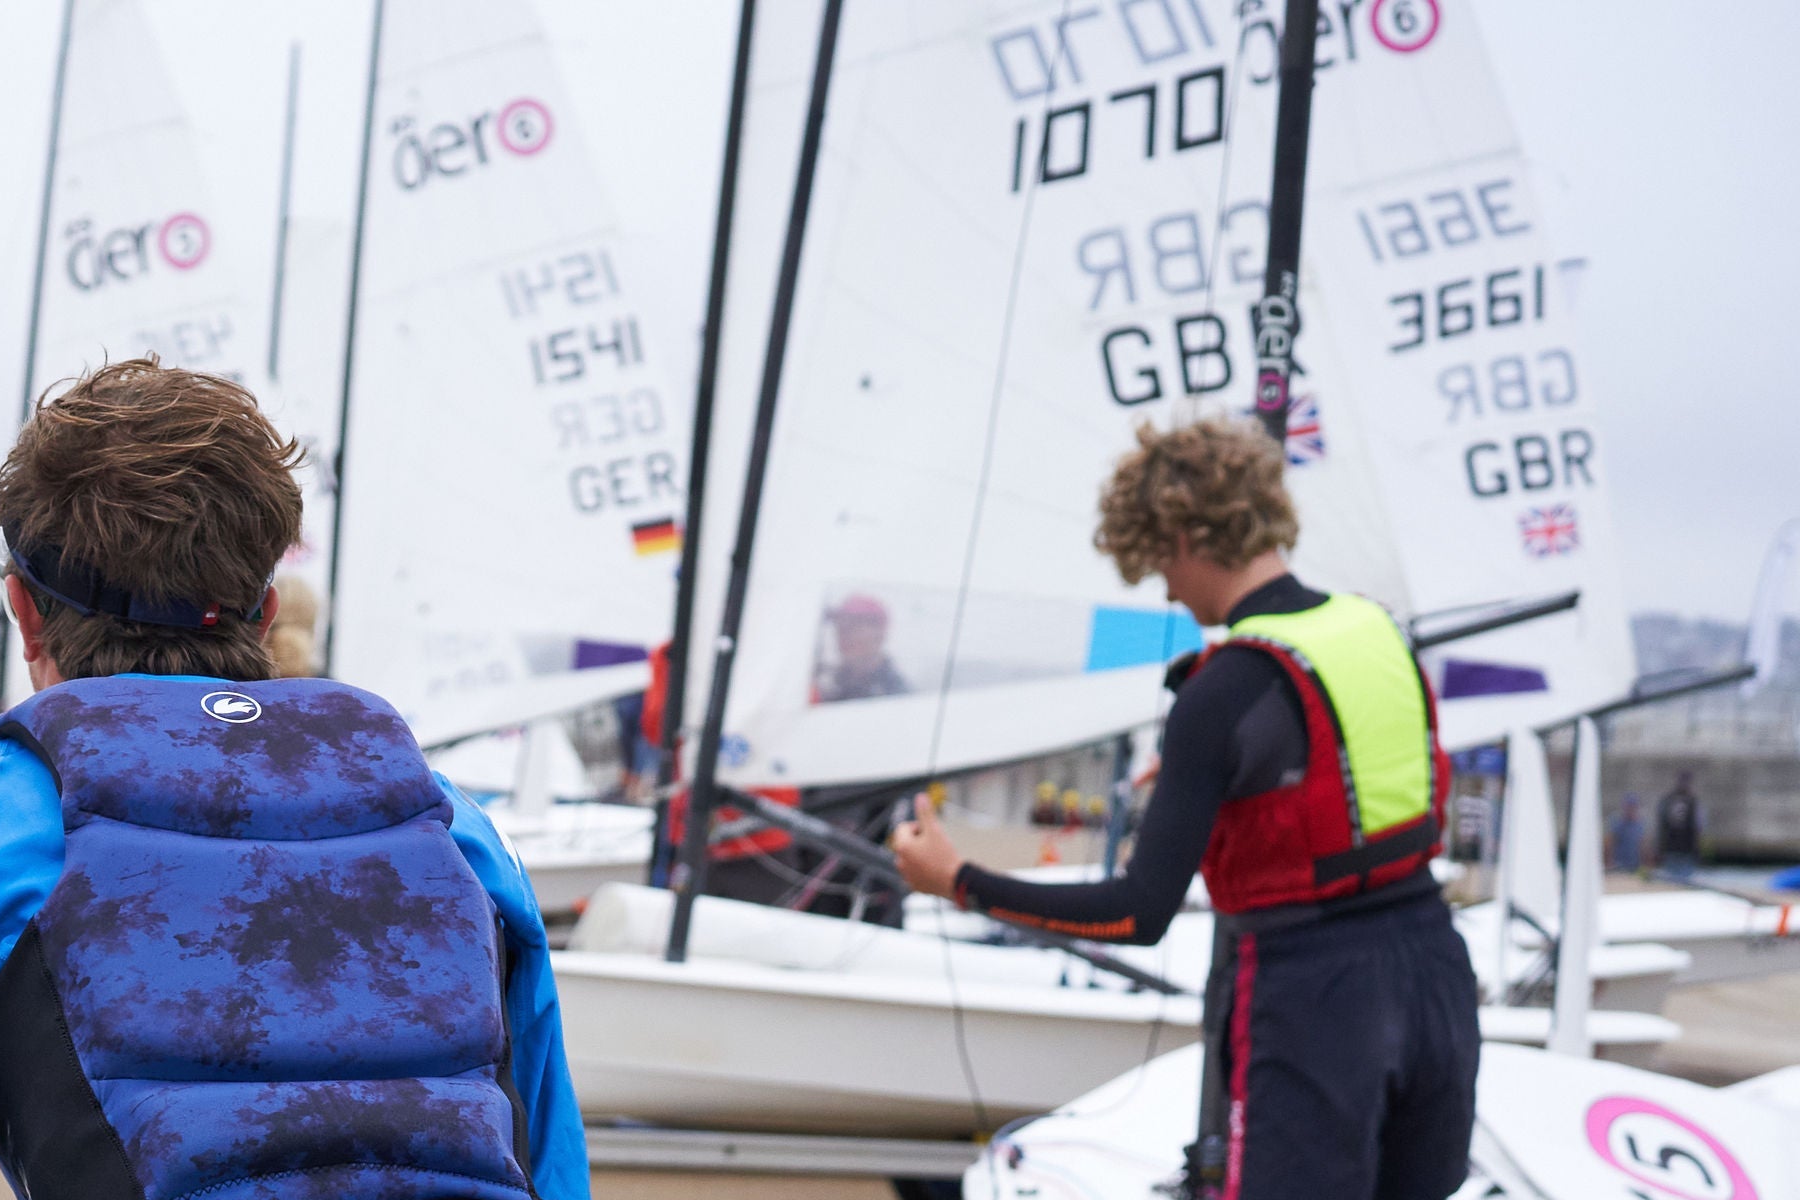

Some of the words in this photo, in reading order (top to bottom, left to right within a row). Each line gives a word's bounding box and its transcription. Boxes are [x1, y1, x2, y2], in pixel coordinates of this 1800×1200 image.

[1011, 65, 1226, 193] 1070
[1387, 265, 1545, 354] 3661
[529, 316, 644, 384] 1541
[568, 451, 681, 514] GER
[1463, 428, 1596, 499] GBR
